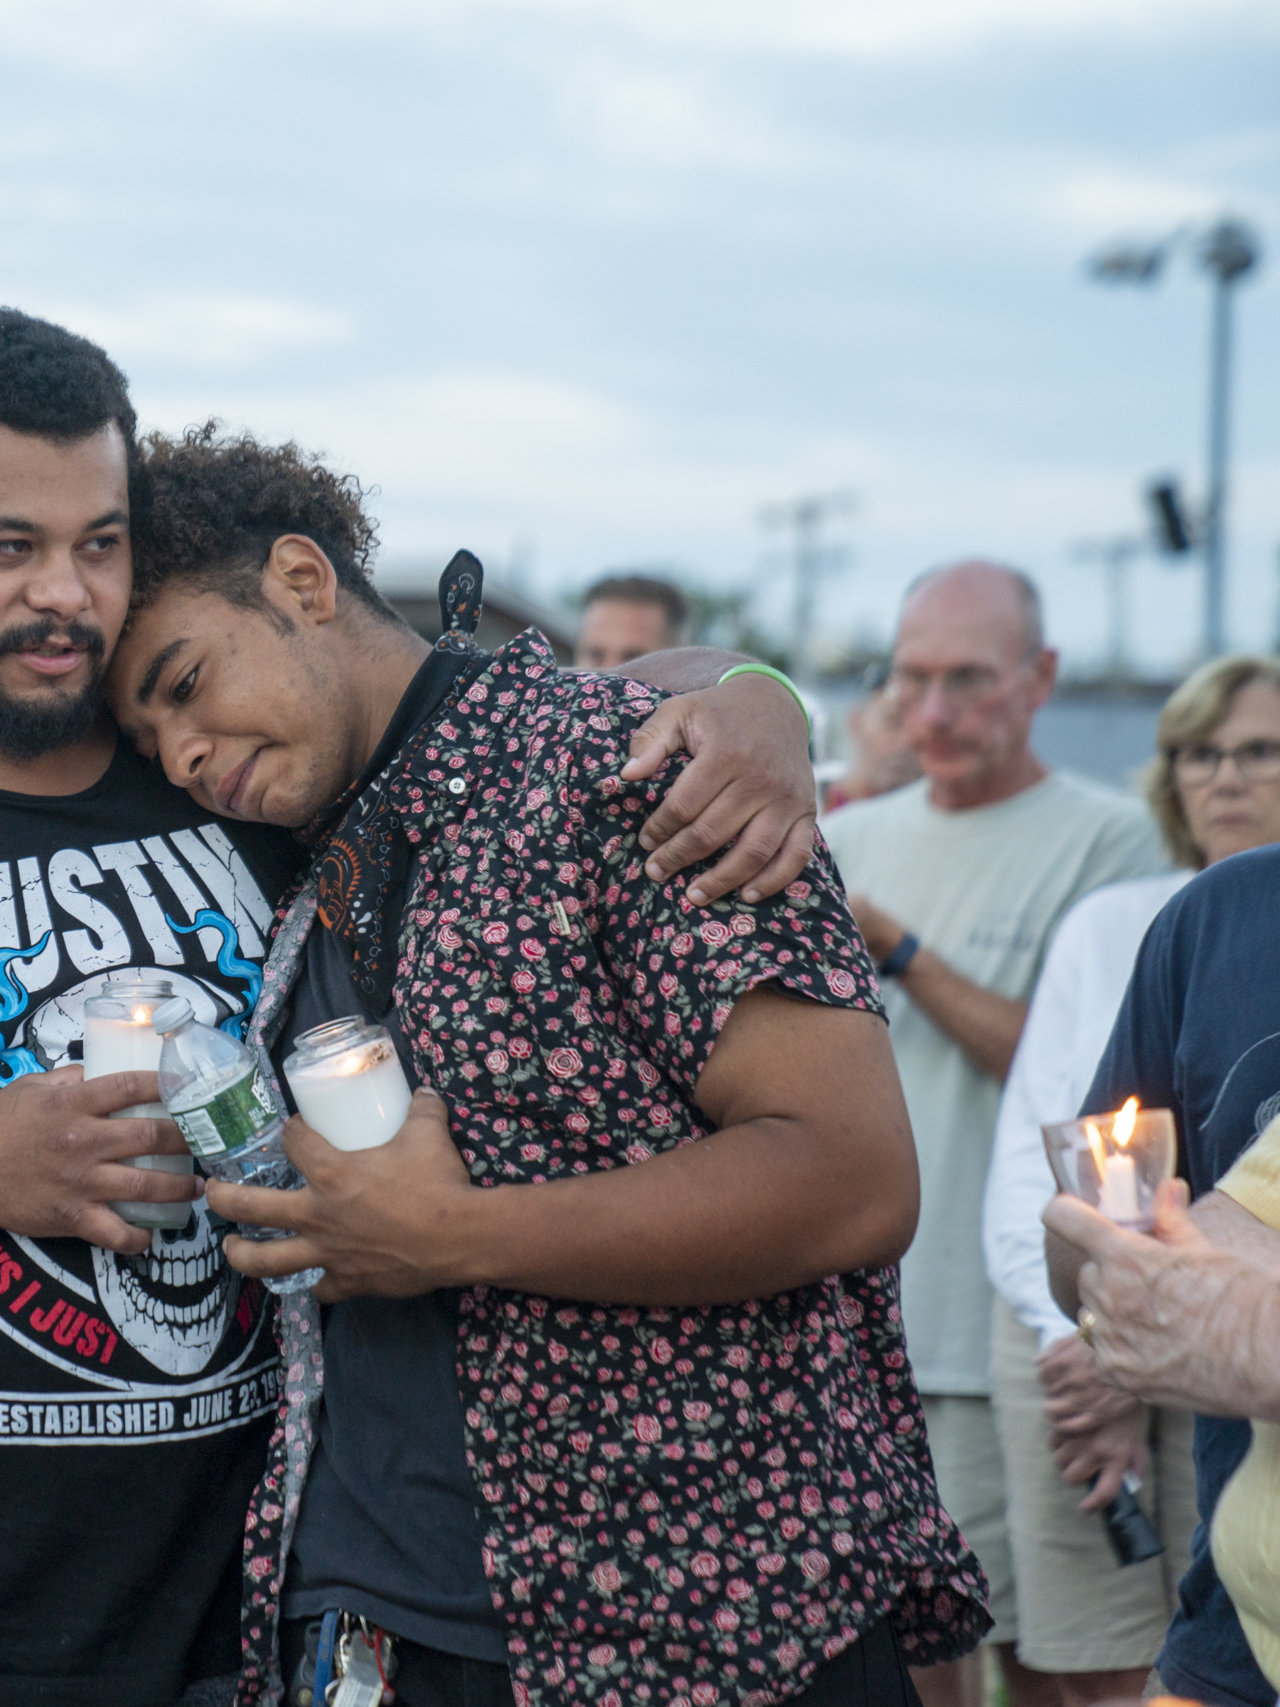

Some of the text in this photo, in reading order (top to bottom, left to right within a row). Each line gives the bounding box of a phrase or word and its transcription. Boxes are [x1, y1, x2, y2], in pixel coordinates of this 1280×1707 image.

[9, 1280, 42, 1314] I
[29, 1298, 118, 1364] JUST
[183, 1389, 232, 1428] JUNE
